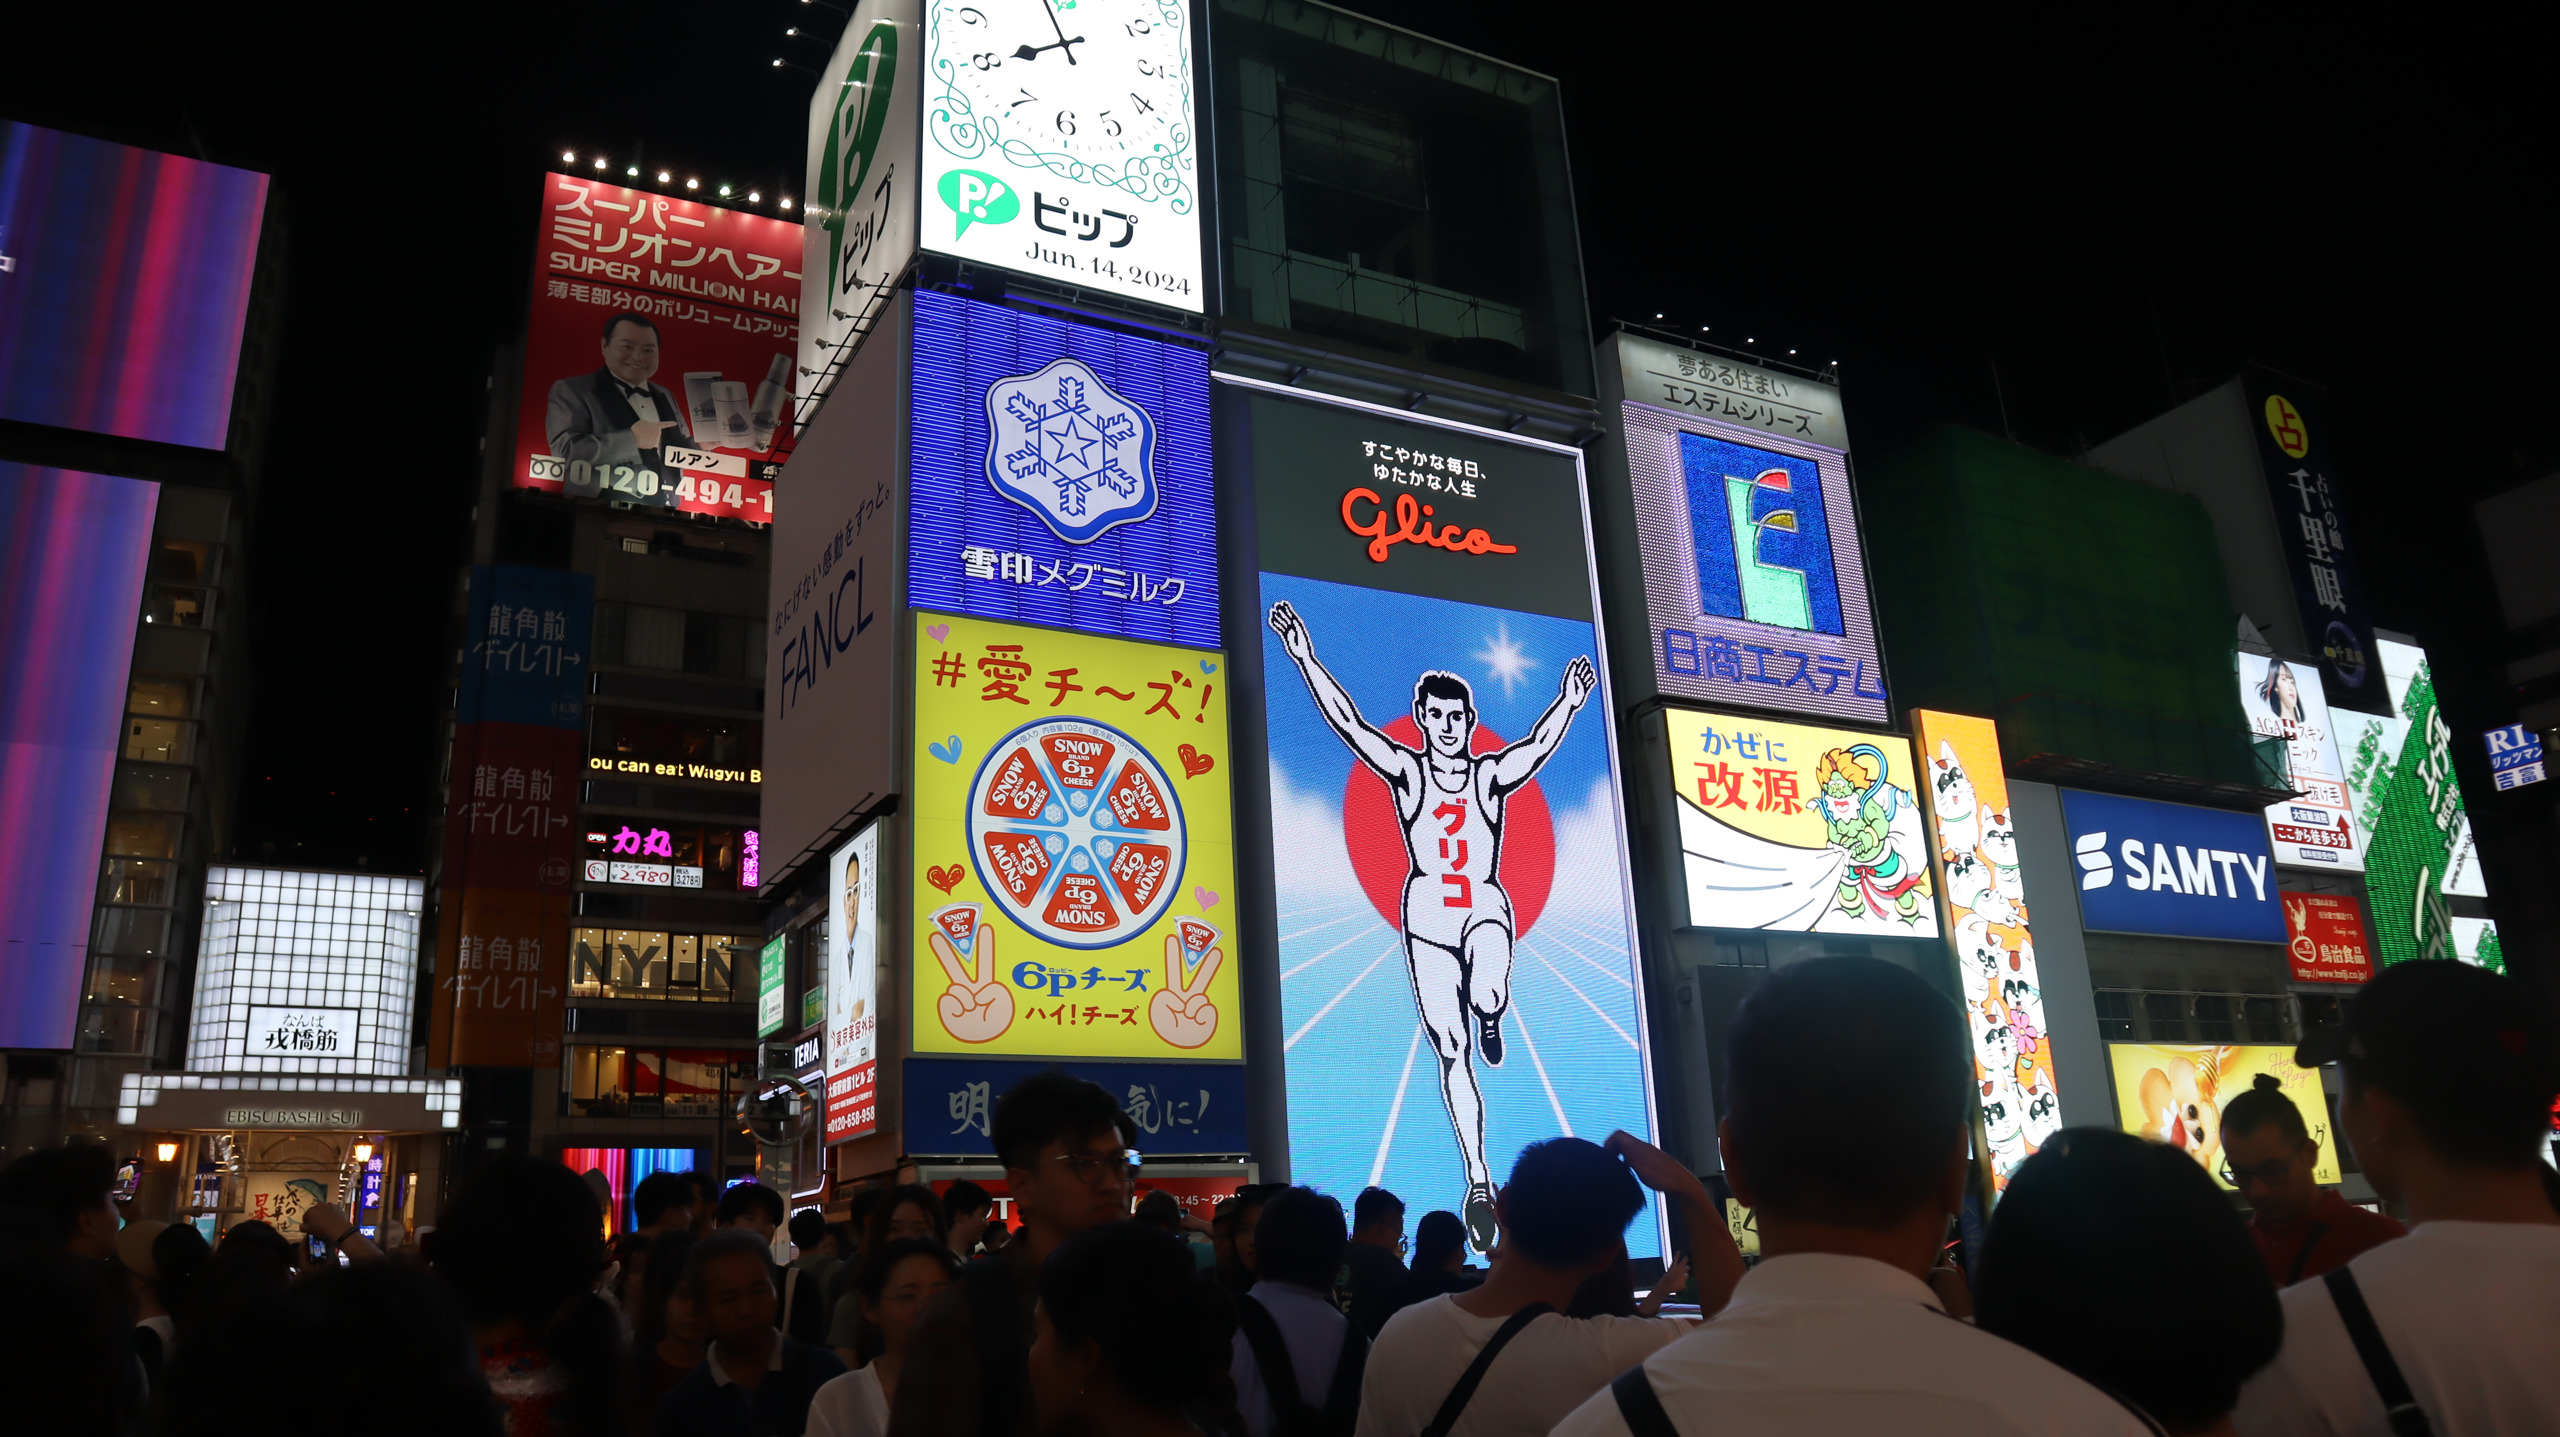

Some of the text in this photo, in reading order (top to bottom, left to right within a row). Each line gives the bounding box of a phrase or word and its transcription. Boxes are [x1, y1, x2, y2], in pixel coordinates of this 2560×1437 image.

[959, 7, 988, 28] 9
[1124, 19, 1150, 37] 2
[972, 52, 1002, 70] 8
[1138, 59, 1164, 79] 3
[1011, 88, 1038, 108] 7
[1130, 92, 1155, 116] 4
[1056, 110, 1077, 136] 6
[1099, 110, 1122, 138] 5
[555, 182, 706, 231] スーパー
[1034, 191, 1139, 249] ピップ
[842, 163, 895, 296] ピップ
[552, 215, 802, 281] ミリオンヘアー
[549, 252, 641, 283] SUPER
[650, 269, 745, 303] MILLION
[1677, 354, 1789, 397] 夢ある住まい
[1663, 383, 1813, 436] エステムシリーズ
[2276, 397, 2303, 452] 占
[670, 451, 719, 468] ルアン
[1362, 440, 1487, 480] すこやかな毎日、
[1374, 465, 1477, 499] ゆたかな人生
[1340, 486, 1517, 562] Glico
[2287, 468, 2347, 614] 千里眼
[774, 481, 890, 636] なにげない感動をずっと。
[960, 545, 1186, 606] 雪印メグミルク
[488, 604, 566, 642] 龍角散
[779, 555, 873, 720] FANCL
[473, 640, 563, 676] ダイレクト
[1664, 628, 1888, 700] 日商エステム
[1700, 726, 1788, 762] かぜに
[2256, 716, 2325, 742] AGA スキン
[1054, 738, 1104, 757] SNOW
[1067, 753, 1090, 761] BRAND
[2416, 716, 2451, 797] エイブル
[2493, 747, 2543, 768] リッツマン
[474, 764, 556, 801] 龍角散
[617, 760, 650, 774] can
[654, 763, 684, 777] eat
[688, 764, 745, 784] Wagyu
[992, 756, 1025, 806] SNOW
[1010, 777, 1024, 798] BRAND
[1063, 776, 1094, 787] CHEESE
[1028, 788, 1048, 817] CHEESE
[1130, 772, 1165, 819] SNOW
[1132, 789, 1147, 811] BRAND
[1694, 761, 1803, 816] 改源
[2308, 783, 2341, 804] 抜け毛
[457, 802, 550, 838] ダイレクト
[1110, 795, 1129, 825] CHEESE
[2436, 783, 2460, 832] 株式会社
[588, 834, 606, 842] OPEN
[2277, 826, 2348, 847] ここから徒歩5分
[1009, 852, 1025, 875] BRAND
[1028, 837, 1049, 868] CHEESE
[1111, 845, 1130, 874] CHEESE
[1432, 798, 1473, 910] グリコ
[990, 844, 1027, 893] SNOW
[1065, 877, 1096, 886] CHEESE
[1134, 863, 1148, 884] BRAND
[1134, 855, 1165, 905] SNOW
[2121, 838, 2267, 901] SAMTY
[944, 911, 970, 923] SNOW
[1054, 909, 1106, 926] SNOW
[1186, 924, 1210, 937] SNOW
[460, 934, 544, 972] 龍角散
[442, 975, 538, 1010] ダイレクト
[283, 1013, 325, 1027] なんば
[836, 1014, 875, 1049] 東京美容外科
[265, 1028, 338, 1051] 戎橋筋
[795, 1038, 819, 1069] TERIA
[227, 1110, 361, 1126] EBISU BASHI-SUJI
